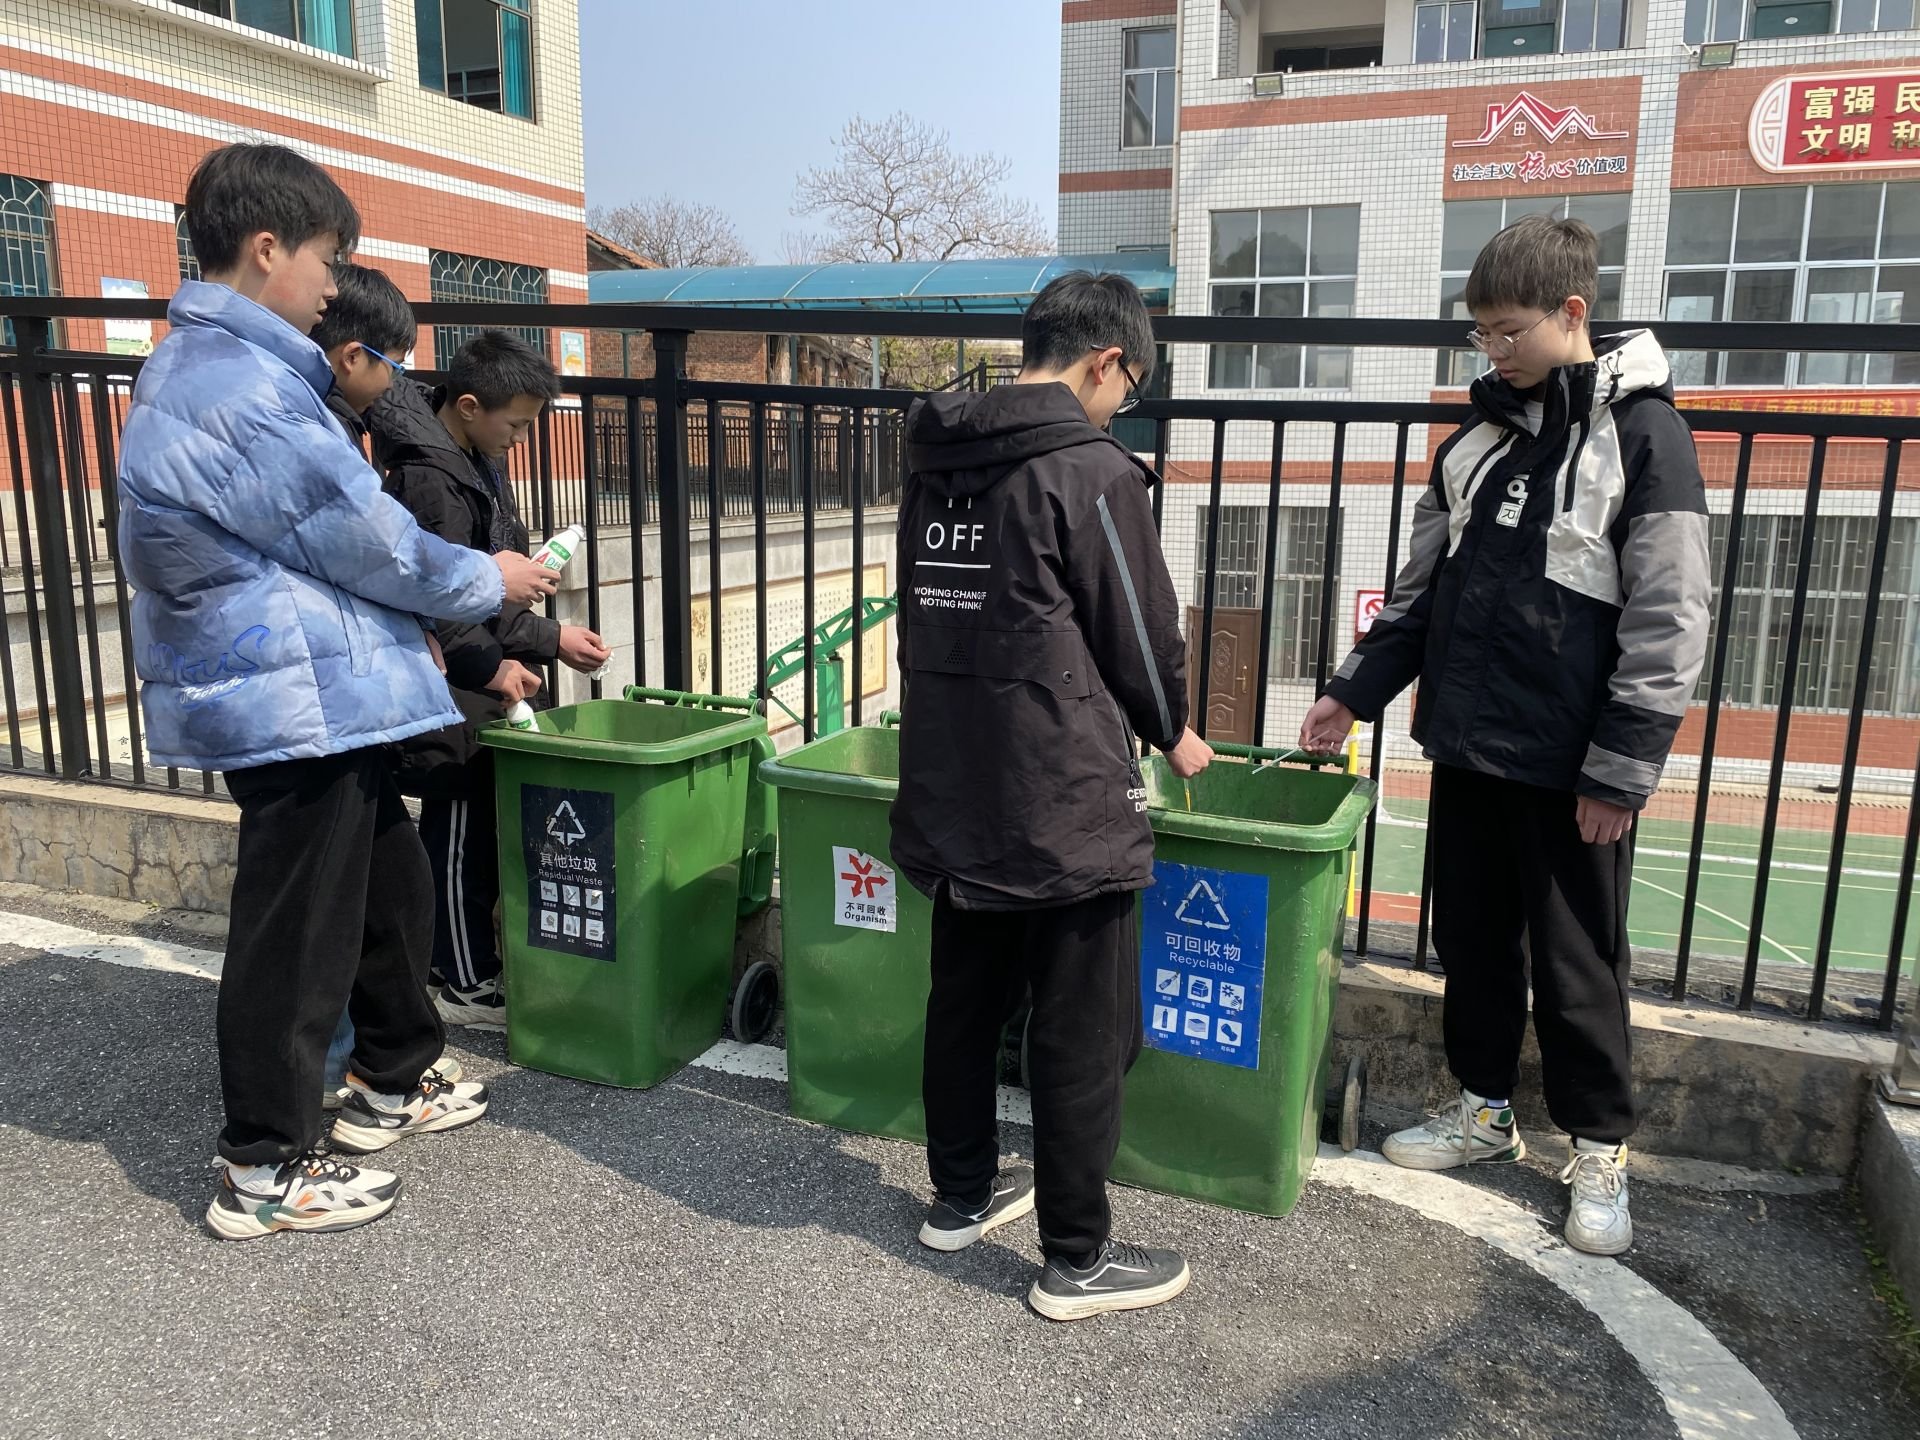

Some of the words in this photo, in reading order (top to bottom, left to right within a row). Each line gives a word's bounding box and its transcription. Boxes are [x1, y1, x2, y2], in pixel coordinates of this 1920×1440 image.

[1804, 86, 1876, 120] 富强
[1798, 123, 1873, 156] 文明
[1453, 151, 1628, 183] 社会主义核心价值观
[926, 522, 984, 551] OFF
[920, 597, 956, 608] NOTING
[540, 852, 597, 872] 其他垃圾
[539, 868, 574, 881] Residual
[575, 874, 603, 886] Waste
[844, 911, 887, 924] Organism
[846, 902, 886, 916] 不可回收
[1165, 931, 1241, 962] 可回收物
[1169, 951, 1235, 974] Recyclable
